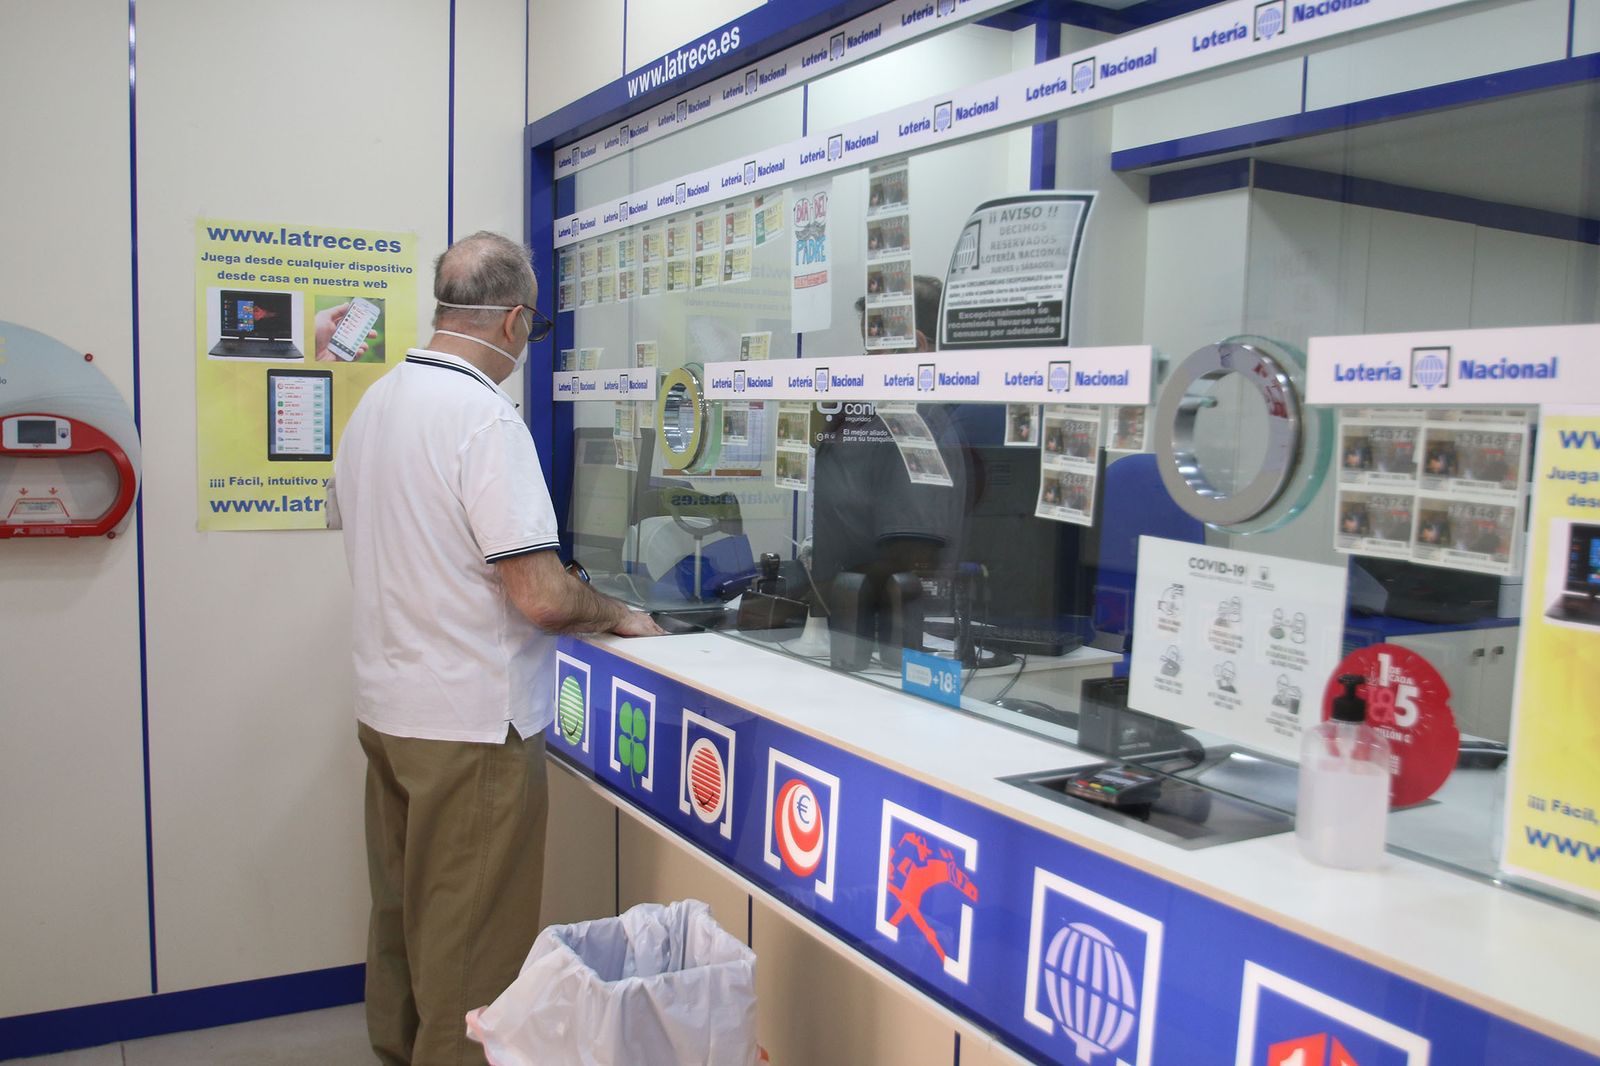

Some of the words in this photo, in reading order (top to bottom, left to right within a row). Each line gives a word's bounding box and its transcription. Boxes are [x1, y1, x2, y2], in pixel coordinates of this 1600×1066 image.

[902, 3, 934, 26] Lotería
[802, 48, 828, 68] Lotería
[847, 22, 882, 49] Nacional
[1192, 23, 1248, 53] Lotería
[628, 26, 740, 98] www.latrece.es
[760, 63, 787, 86] Nacional
[1025, 77, 1067, 101] Lotería
[1100, 48, 1157, 79] Nacional
[898, 117, 931, 137] Lotería
[955, 97, 999, 122] Nacional
[800, 147, 826, 165] Lotería
[844, 131, 879, 152] Nacional
[721, 172, 742, 188] Lotería
[757, 159, 785, 177] Nacional
[1000, 206, 1042, 222] AVISO
[207, 226, 401, 253] www.latrece.es
[795, 235, 827, 266] PADRE
[201, 251, 241, 265] Juega
[245, 255, 283, 266] desde
[287, 258, 345, 271] cualquier
[349, 261, 413, 274] dispositivo
[217, 270, 255, 282] desde
[260, 274, 290, 284] casa
[294, 276, 309, 285] en
[313, 277, 359, 288] nuestra
[363, 279, 388, 290] web
[958, 307, 1036, 320] Excepcionalmente
[788, 375, 813, 388] Lotería
[831, 373, 864, 388] Nacional
[883, 372, 915, 388] Lotería
[938, 371, 980, 387] Nacional
[1004, 369, 1044, 387] Lotería
[1074, 368, 1129, 387] Nacional
[1333, 359, 1403, 382] Lotería
[1458, 356, 1559, 380] Nacional
[711, 378, 733, 389] Lotería
[746, 375, 774, 389] Nacional
[229, 475, 264, 488] Fácil,
[268, 476, 318, 486] intuitivo
[322, 478, 329, 487] y
[1545, 466, 1599, 484] Juega
[210, 495, 328, 513] www.latr
[1188, 557, 1245, 577] COVID-19
[1394, 683, 1419, 728] 5
